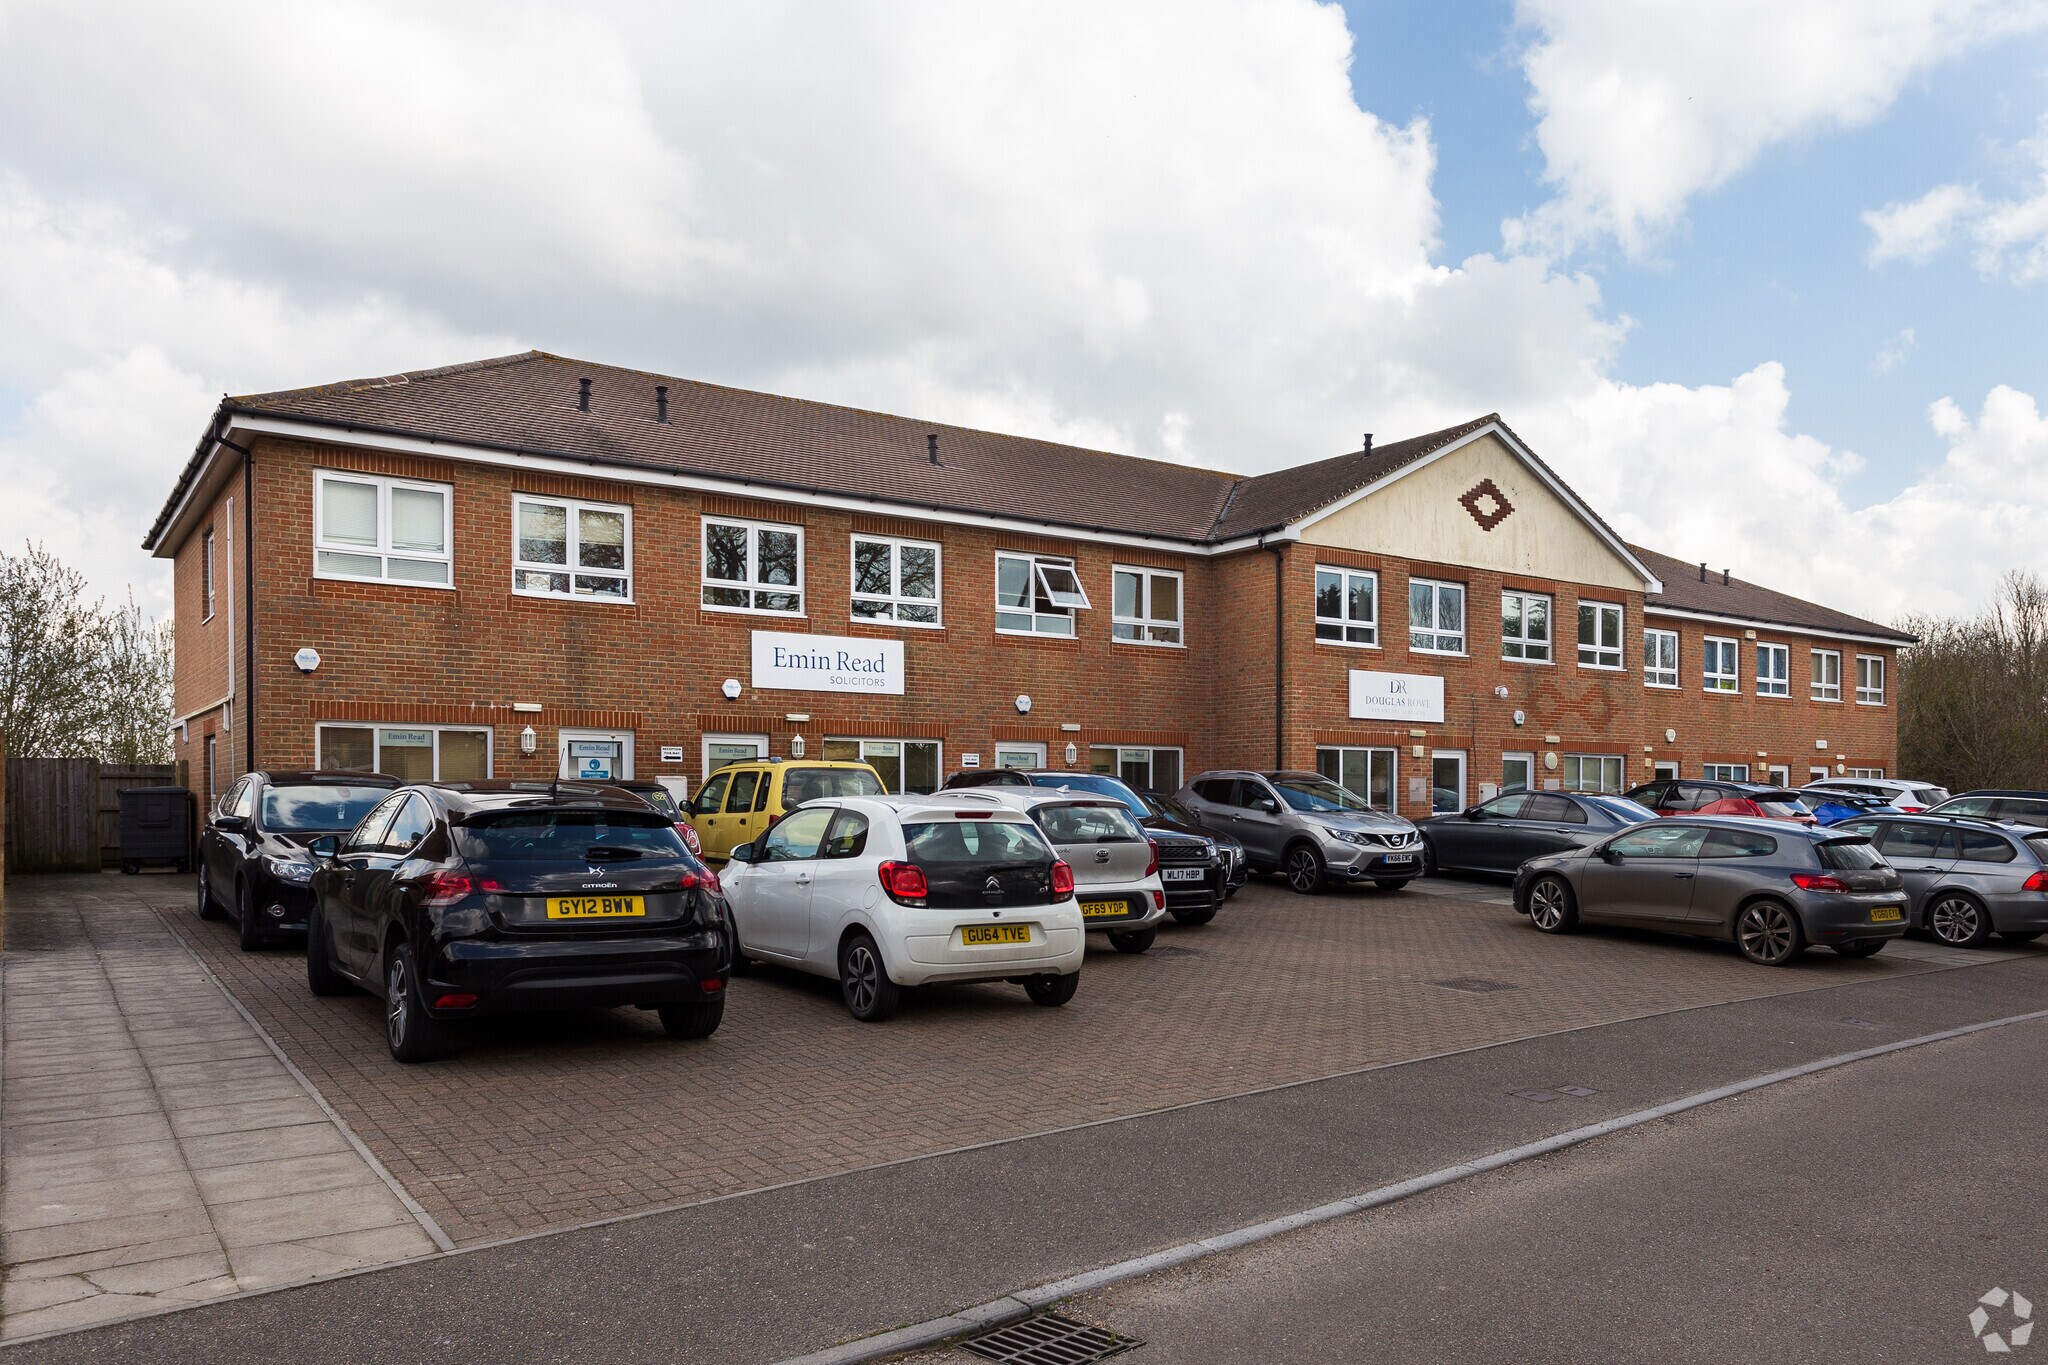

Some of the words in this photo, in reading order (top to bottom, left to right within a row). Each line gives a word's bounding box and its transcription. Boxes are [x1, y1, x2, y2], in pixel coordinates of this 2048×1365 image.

[773, 646, 831, 670] Emin
[836, 651, 886, 673] Read
[829, 675, 885, 687] SOLICITORS
[1390, 679, 1408, 694] DR
[1365, 695, 1406, 706] DOUGLAS
[1407, 698, 1431, 708] ROWE
[1371, 706, 1400, 714] FINANCIAL
[1167, 870, 1184, 880] WL17
[1185, 870, 1200, 879] HBP
[559, 899, 598, 915] GY12
[601, 898, 633, 914] BWW
[1082, 904, 1106, 915] GF69
[1107, 902, 1124, 913] YDP
[967, 929, 999, 942] GU64
[1001, 927, 1026, 941] TVE
